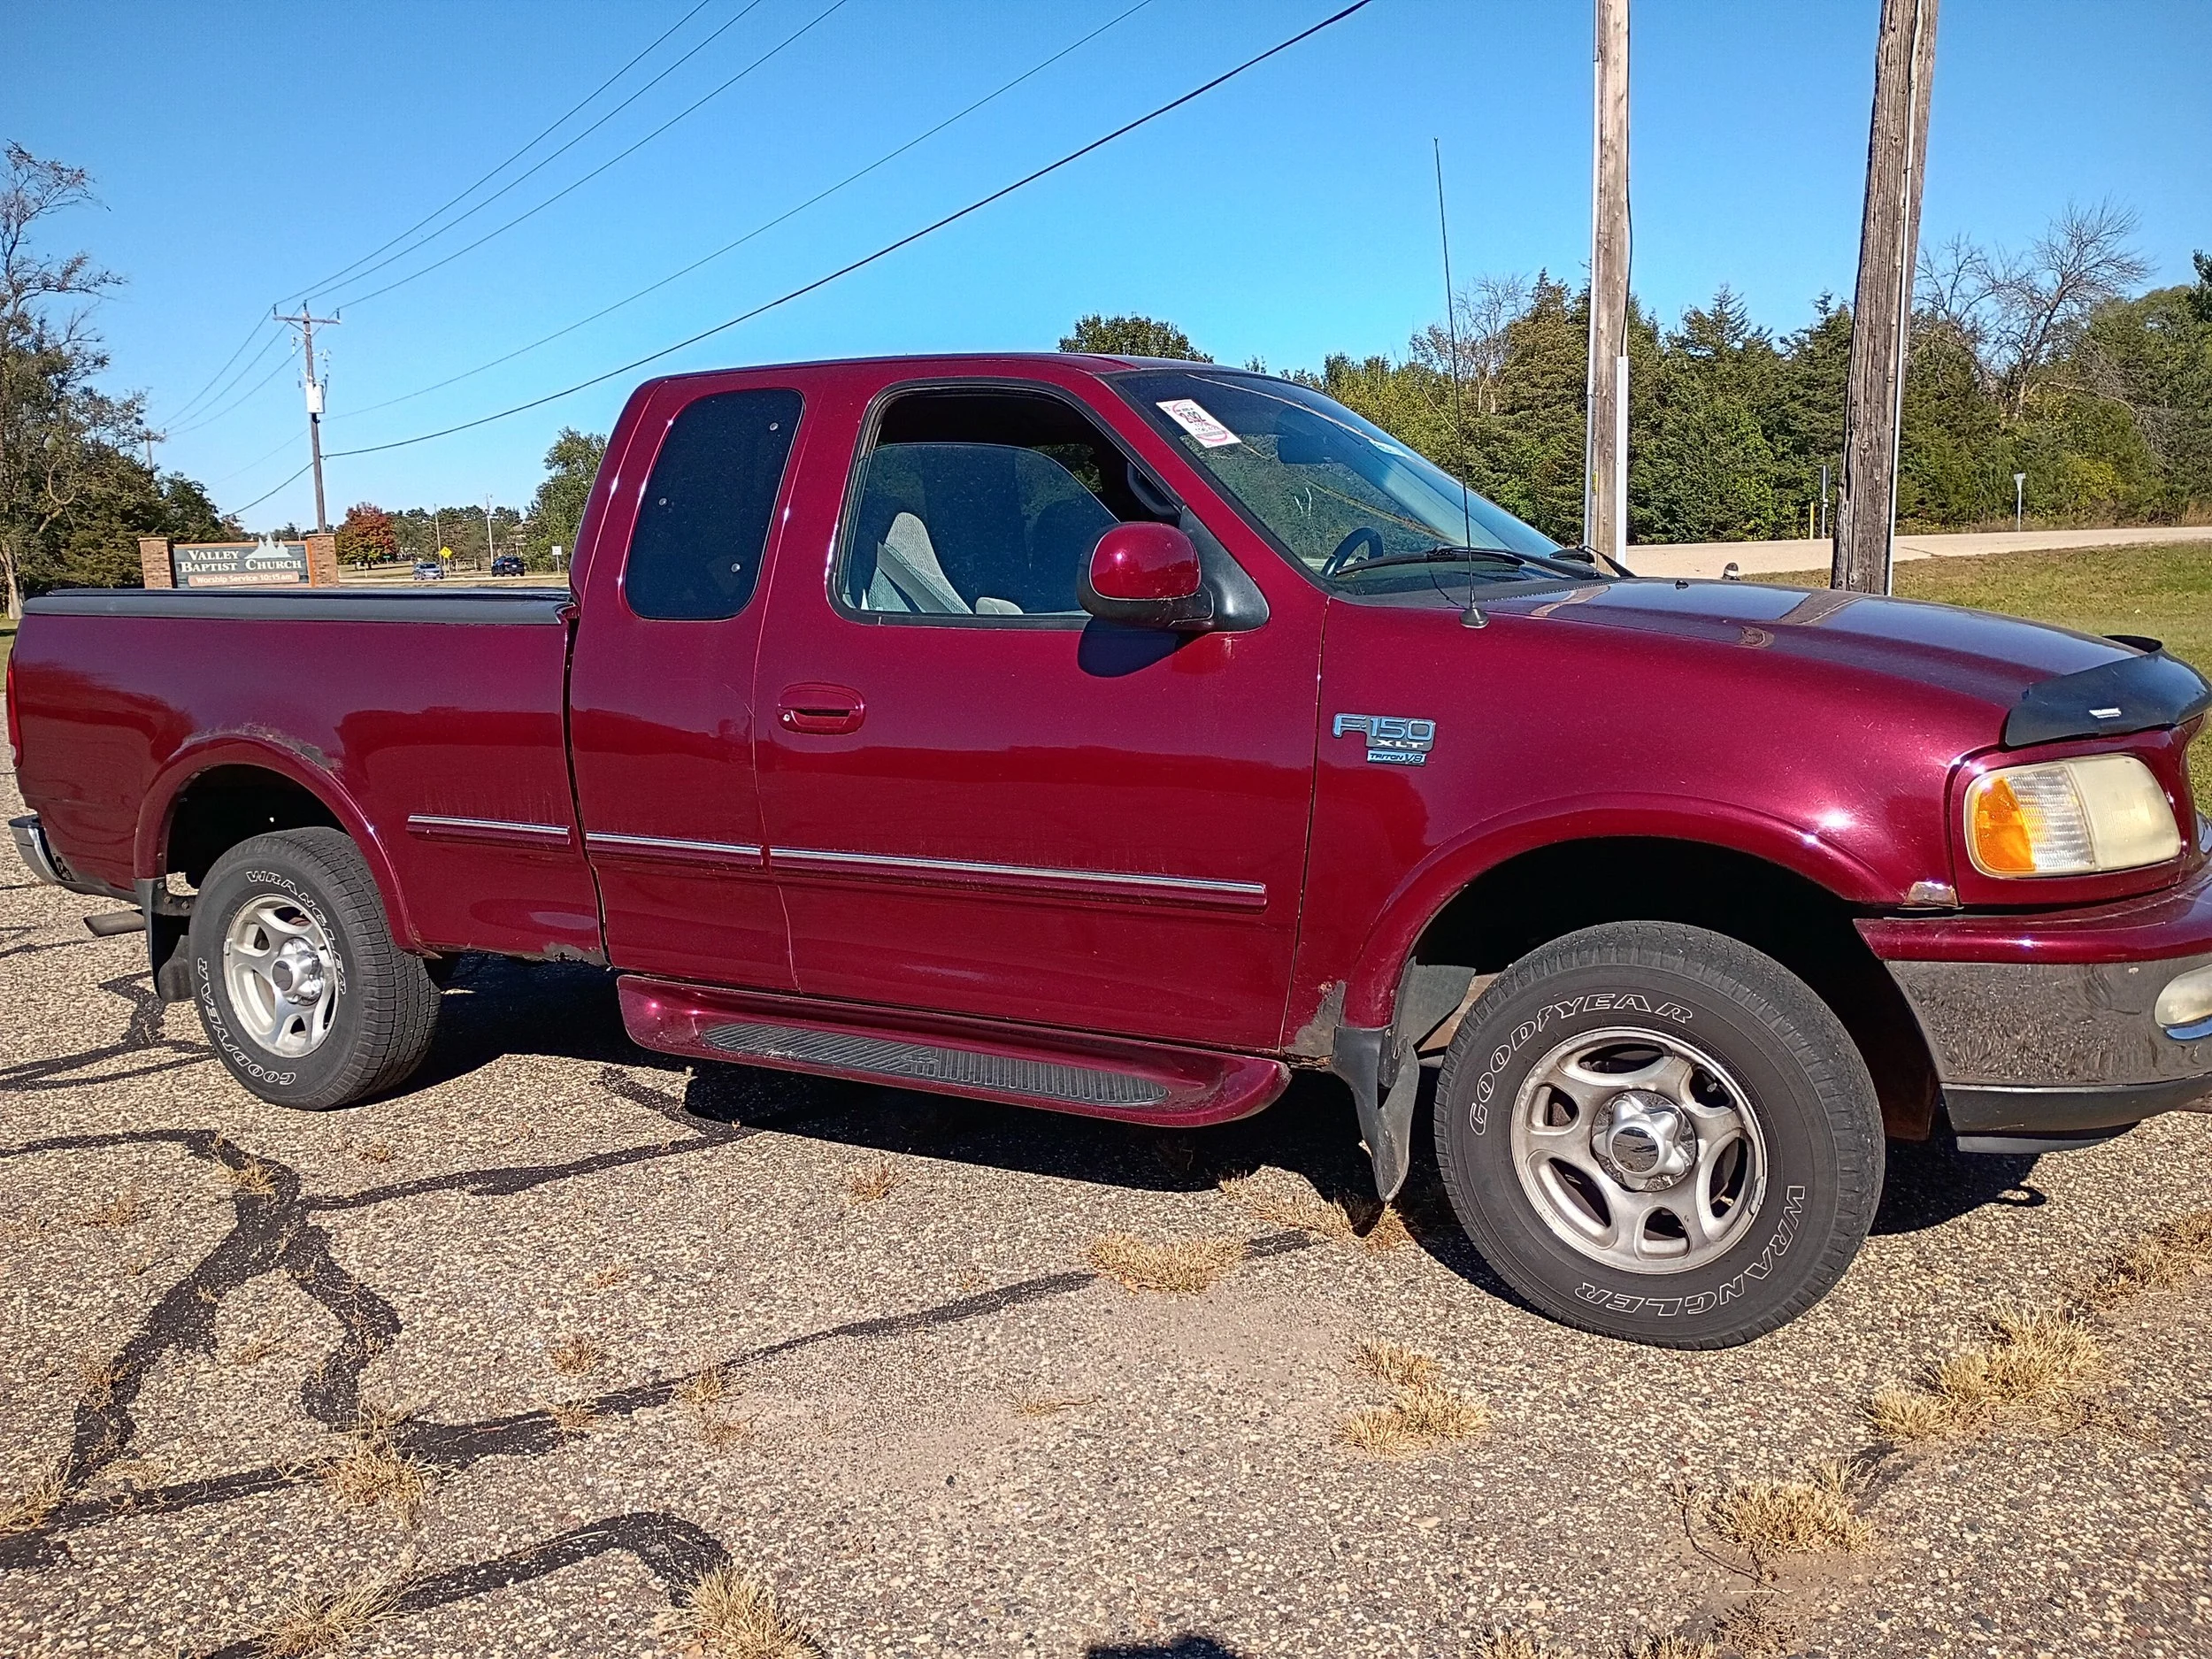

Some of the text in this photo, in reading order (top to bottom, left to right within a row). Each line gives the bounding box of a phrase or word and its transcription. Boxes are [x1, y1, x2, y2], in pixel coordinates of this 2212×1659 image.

[188, 550, 239, 560] VALLEY
[180, 559, 302, 572] BAPTIST CHURCH
[196, 575, 227, 584] Worship
[1376, 739, 1424, 749] XLT
[1370, 752, 1424, 764] TRITON V8
[197, 957, 296, 1086] GOODYEAR
[1469, 993, 1694, 1136] GOODYEAR
[1575, 1185, 1806, 1317] WRANGLER
